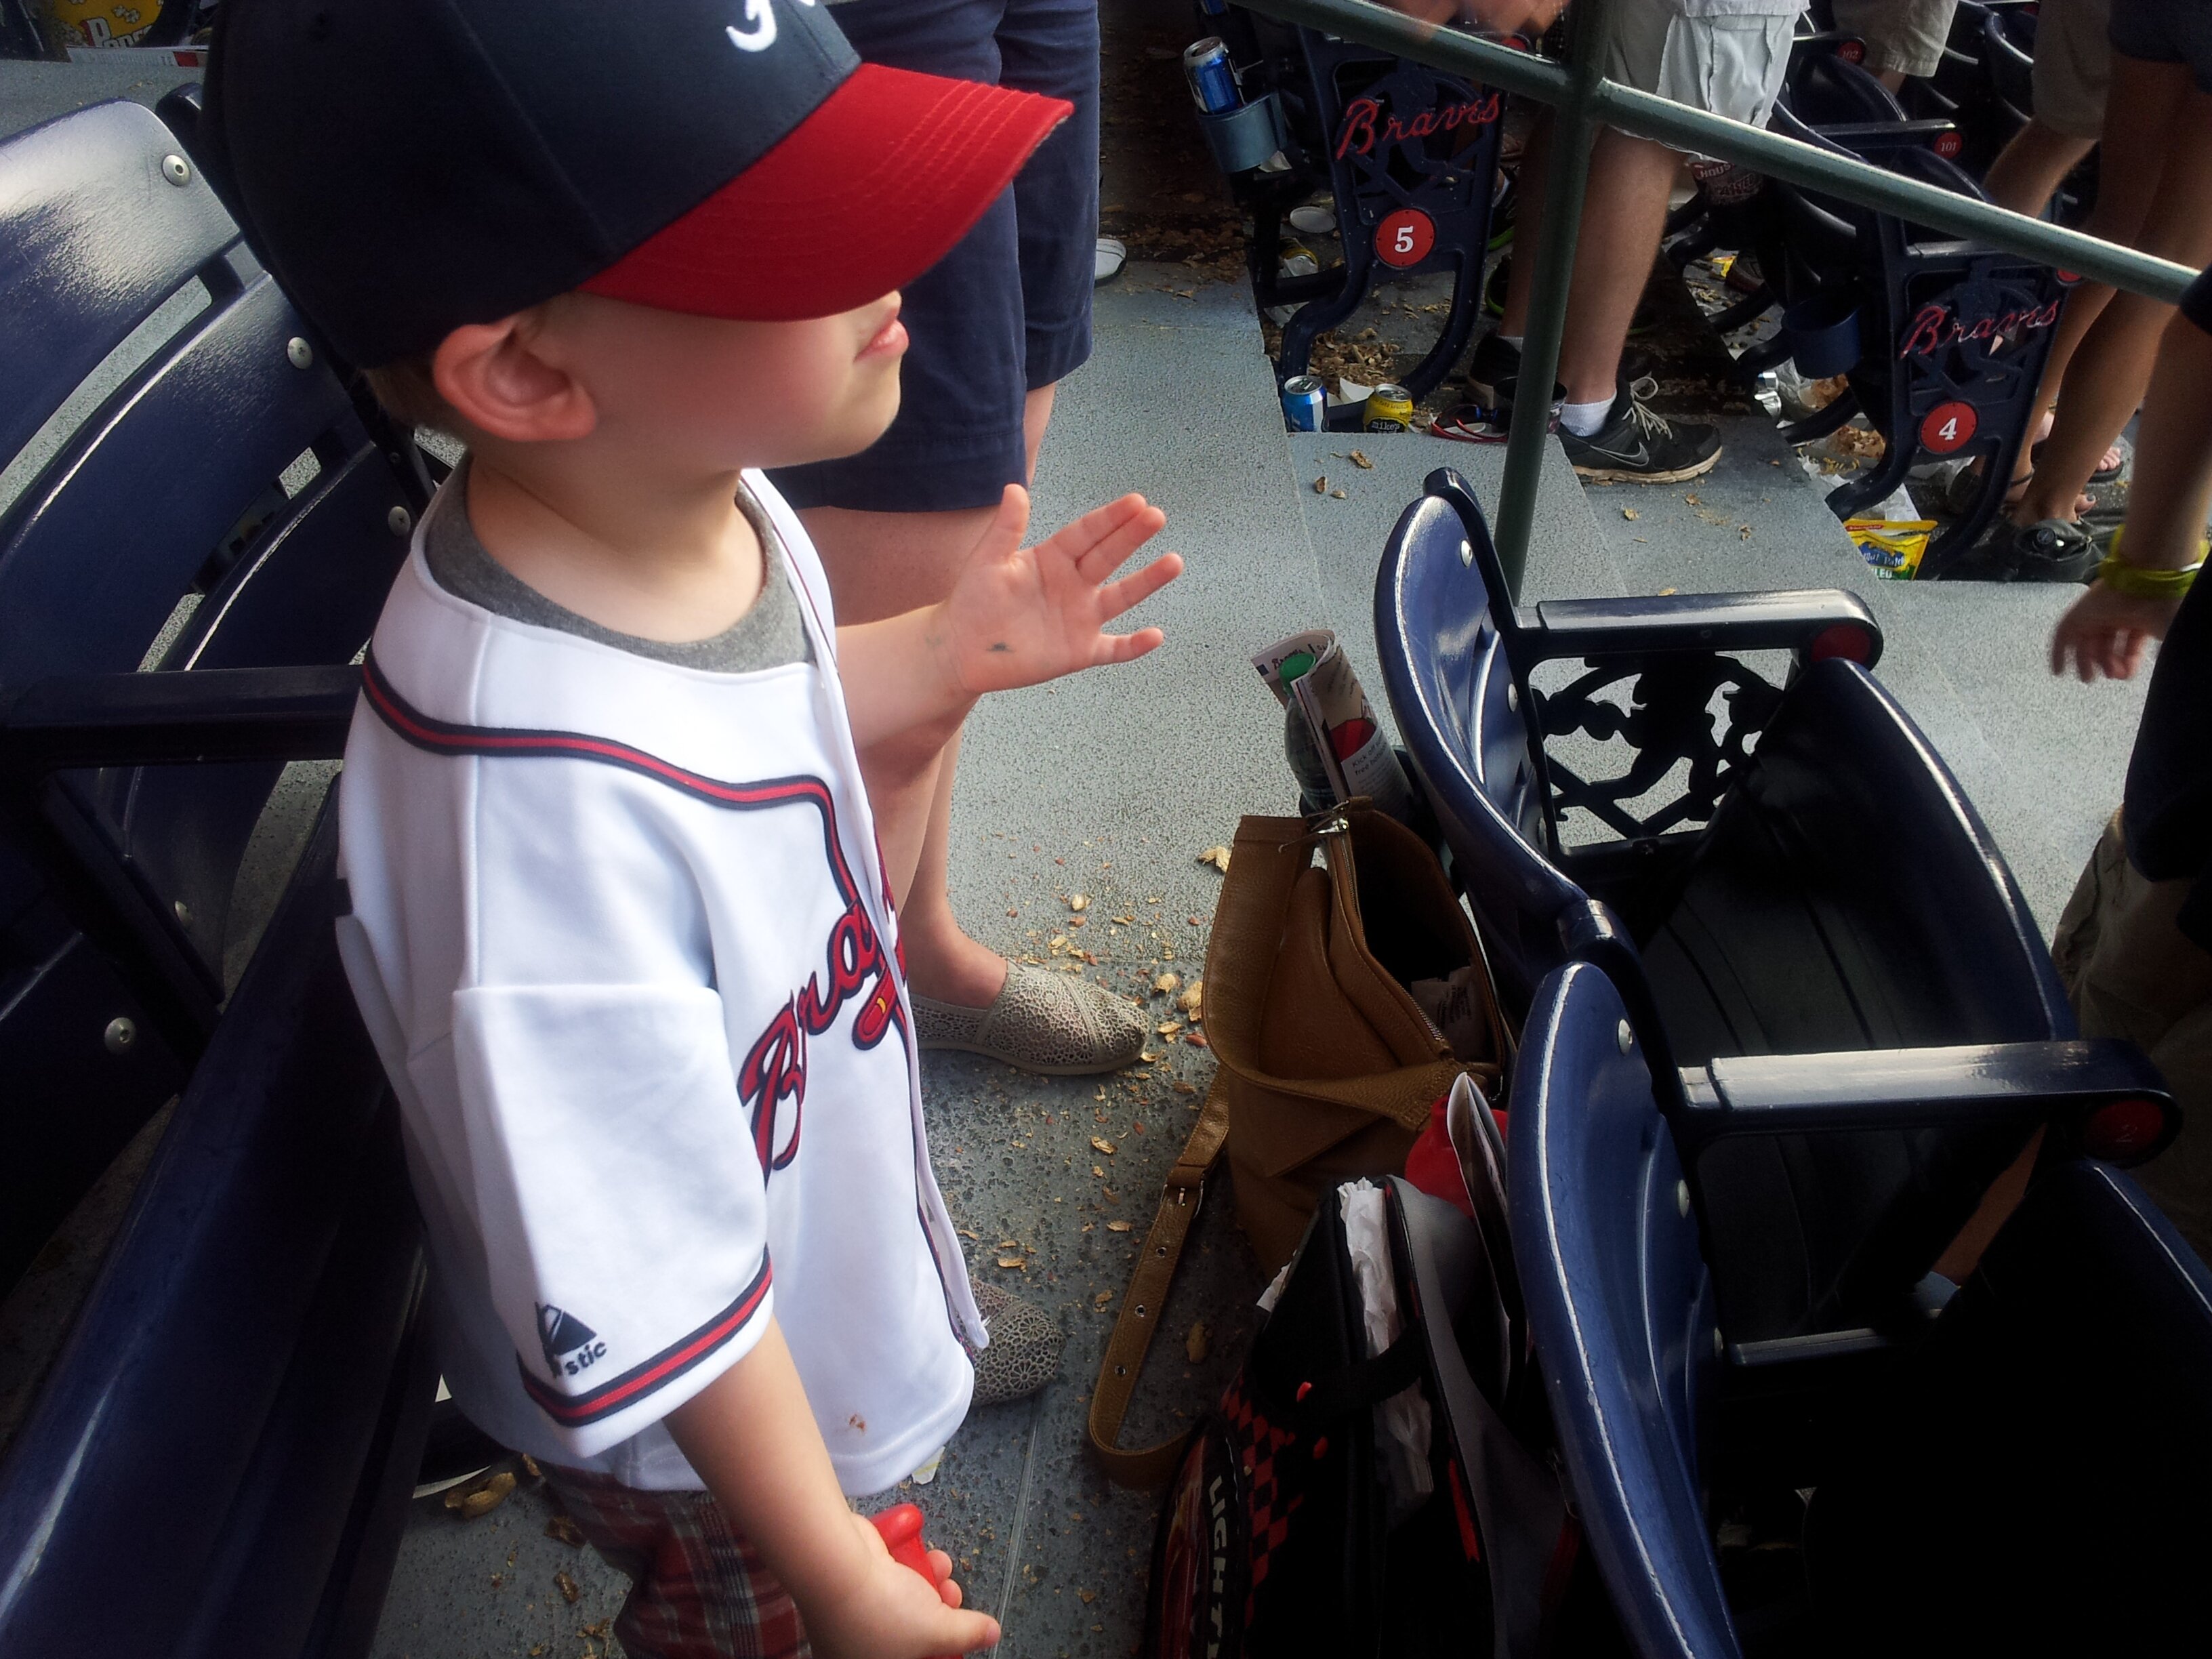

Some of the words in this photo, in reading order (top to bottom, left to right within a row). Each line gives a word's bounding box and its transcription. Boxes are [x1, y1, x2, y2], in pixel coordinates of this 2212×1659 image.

[1336, 94, 1499, 160] Braves
[1940, 142, 1957, 152] 101
[1700, 163, 1732, 178] HOUS
[1395, 226, 1414, 253] 5
[1900, 300, 2059, 359] Braves
[1938, 417, 1957, 441] 4
[564, 1341, 607, 1376] stic
